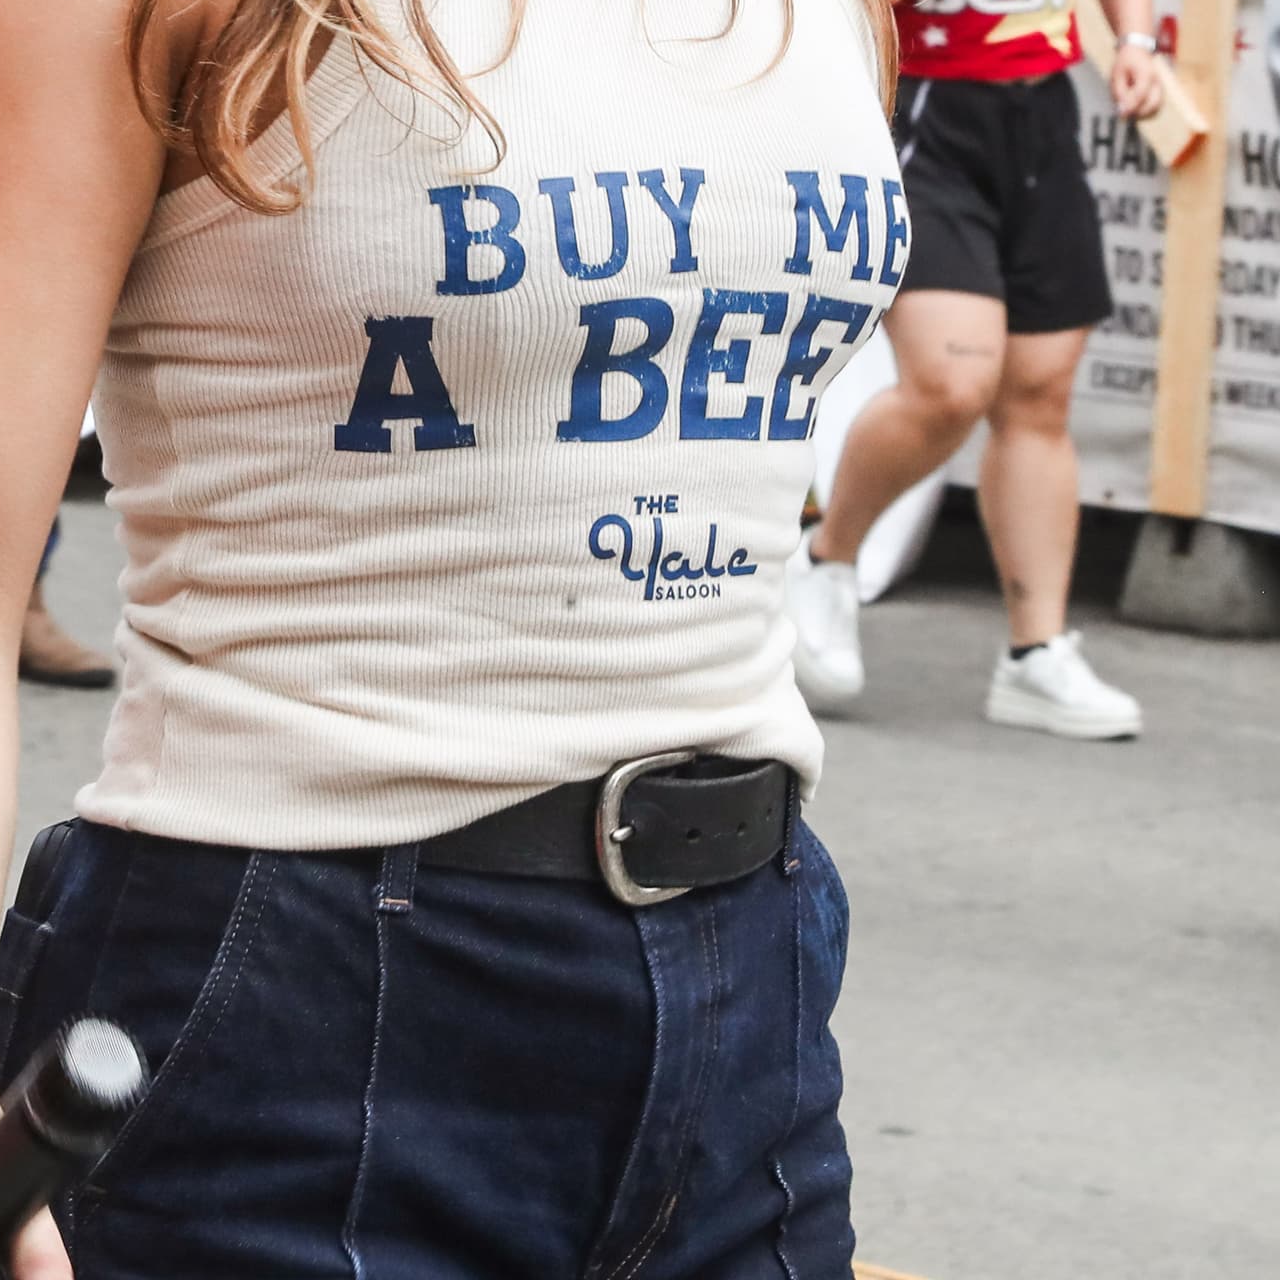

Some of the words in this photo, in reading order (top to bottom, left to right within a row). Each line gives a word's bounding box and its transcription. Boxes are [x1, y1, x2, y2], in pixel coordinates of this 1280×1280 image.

[427, 167, 706, 296] BUY
[783, 170, 907, 287] ME
[334, 315, 477, 453] A
[556, 287, 888, 442] BEE
[633, 495, 679, 515] THE
[588, 513, 758, 601] Yale
[655, 583, 721, 601] SALOON
